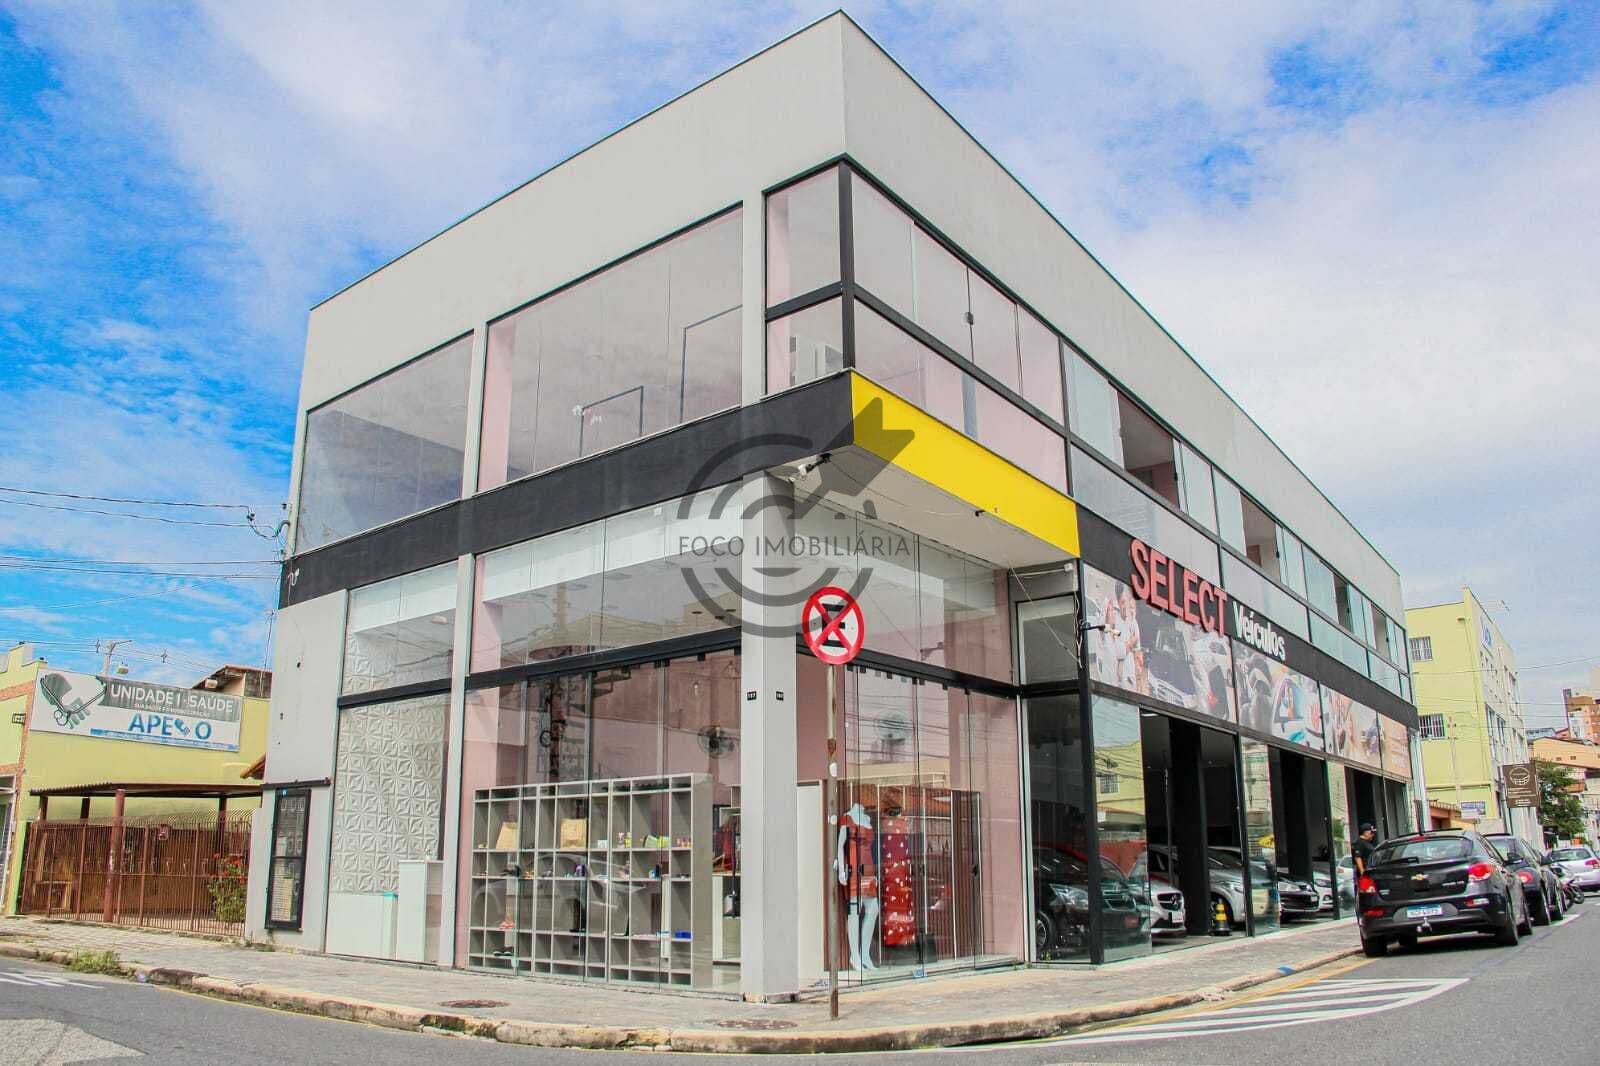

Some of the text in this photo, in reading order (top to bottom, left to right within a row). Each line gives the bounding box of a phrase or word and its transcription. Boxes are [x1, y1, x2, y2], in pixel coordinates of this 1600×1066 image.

[1130, 538, 1286, 662] SELECT Veículos
[110, 683, 174, 705] UNIDADE
[190, 694, 234, 713] SAÚDE
